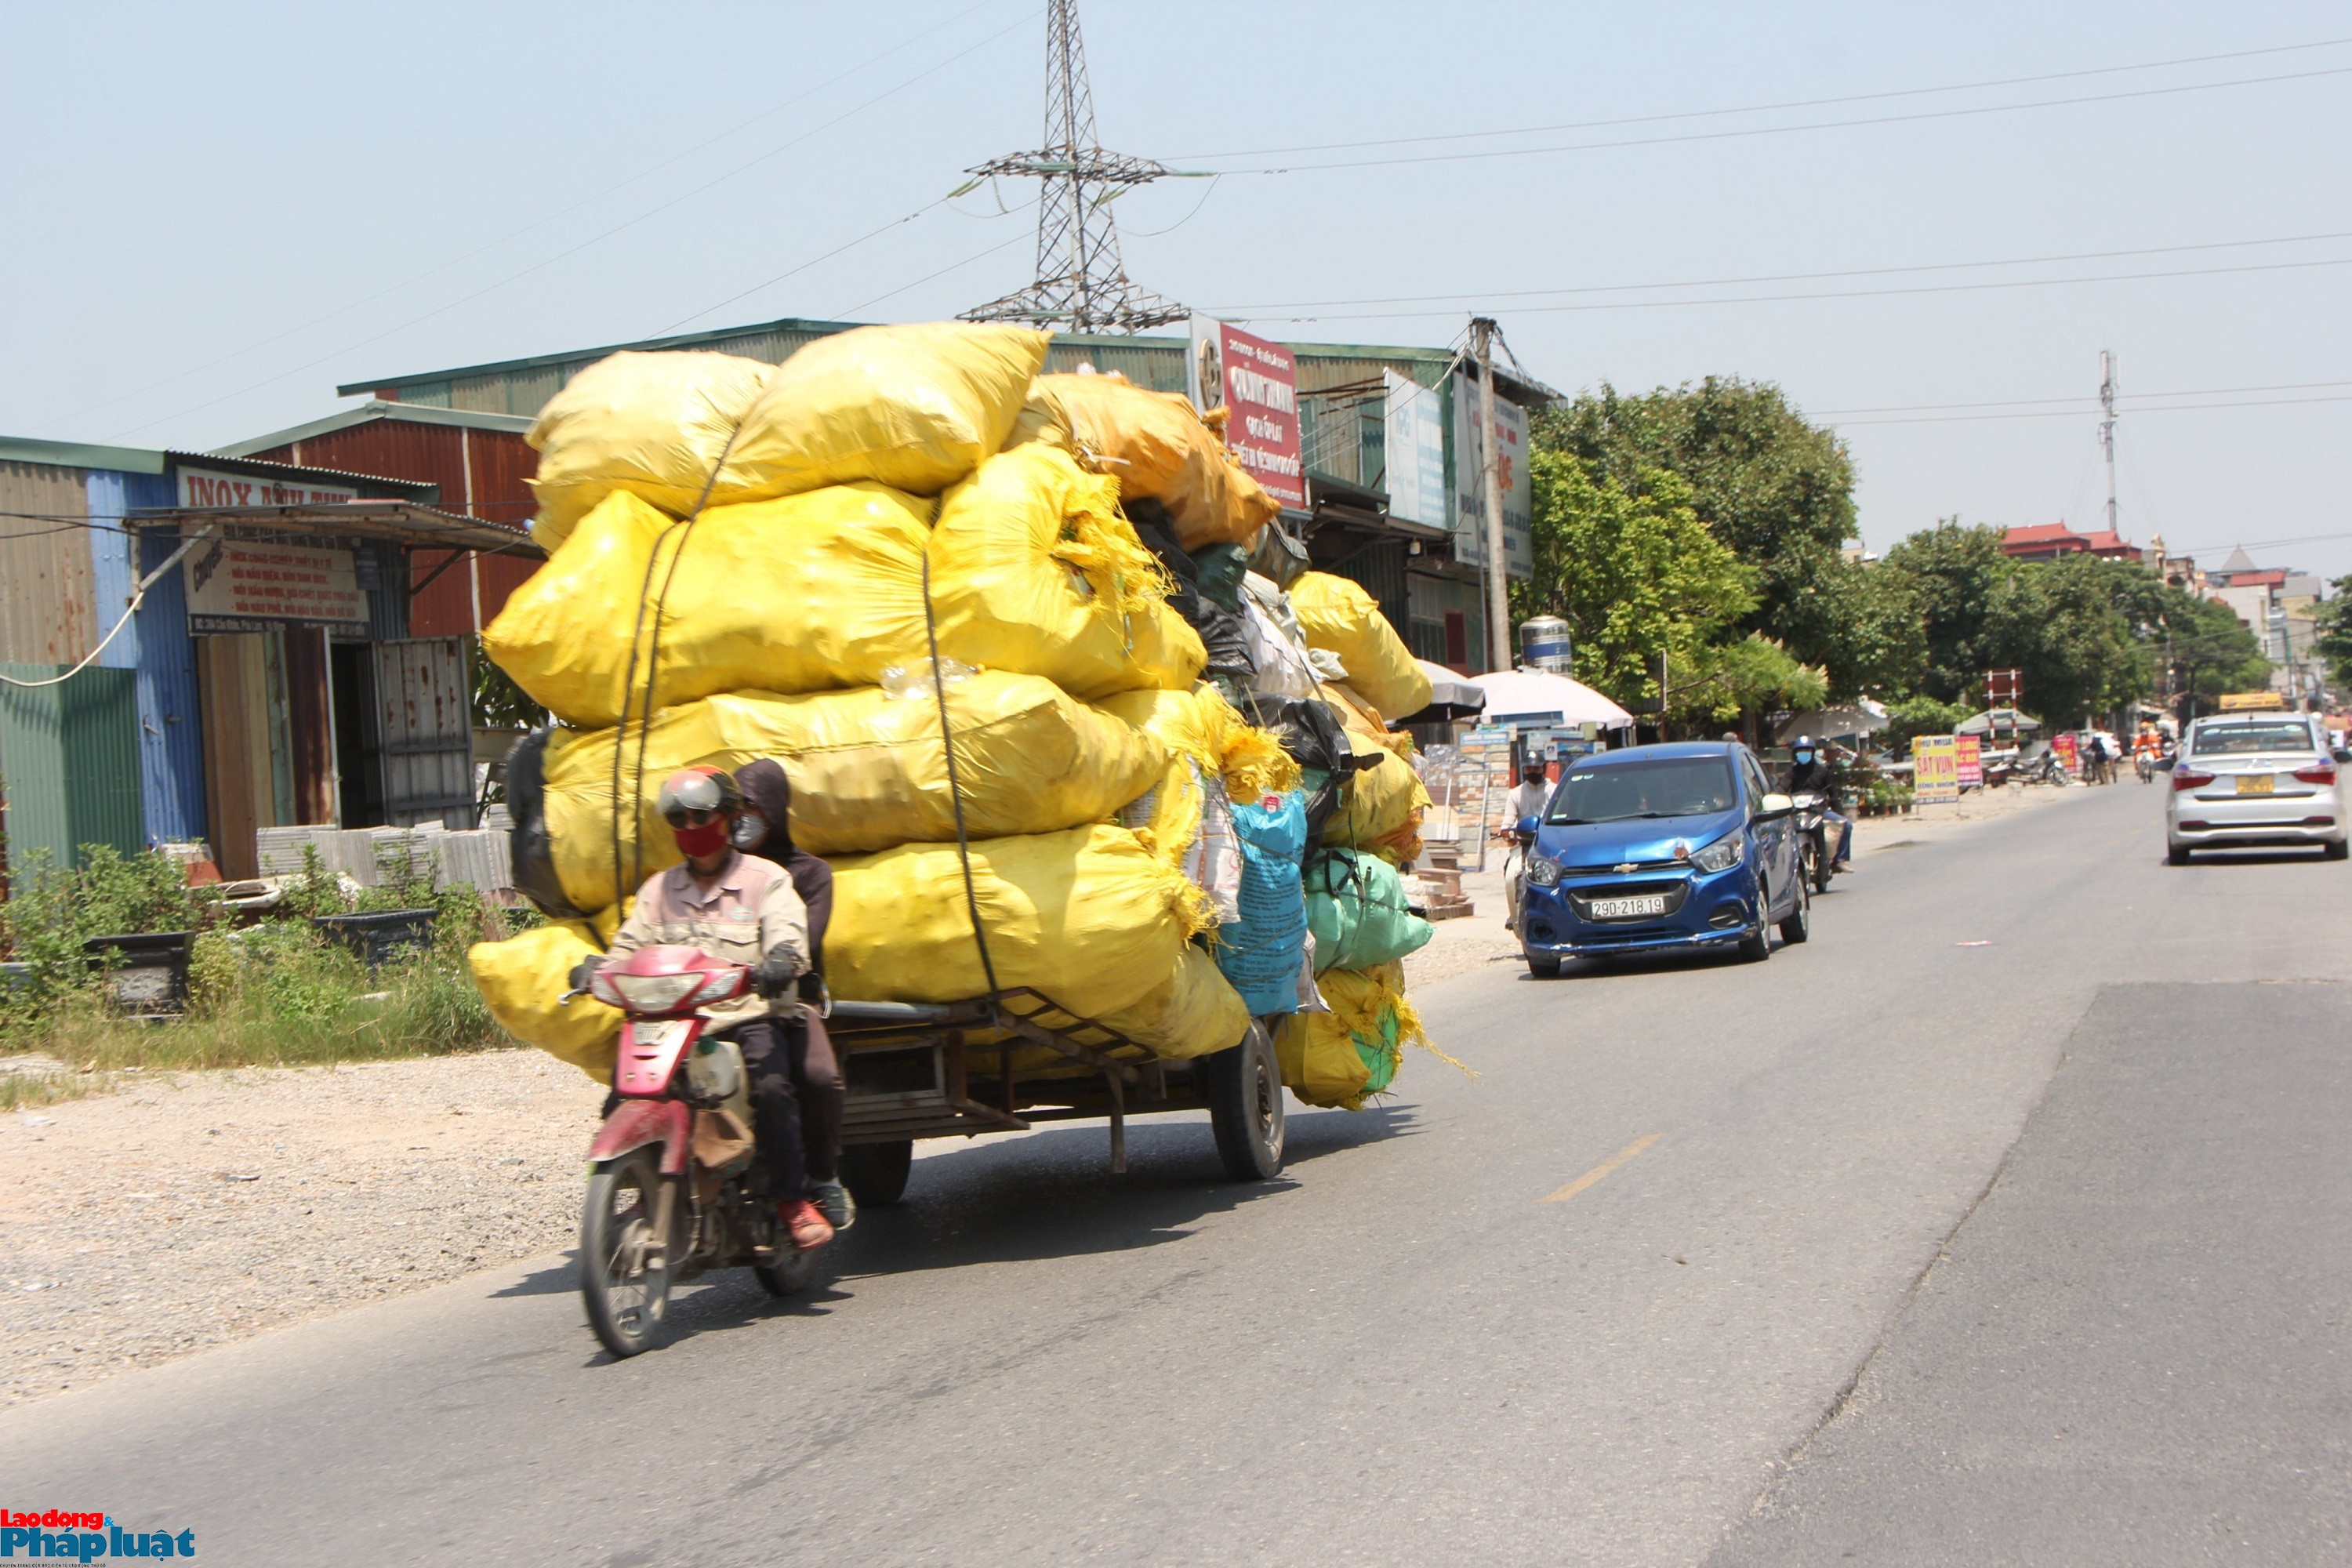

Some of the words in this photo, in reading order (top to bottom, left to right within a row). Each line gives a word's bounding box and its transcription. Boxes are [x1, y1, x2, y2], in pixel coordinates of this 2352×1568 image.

[187, 476, 252, 506] INOX
[1916, 750, 1933, 775] SẮT
[1594, 898, 1662, 916] 29D-218.19
